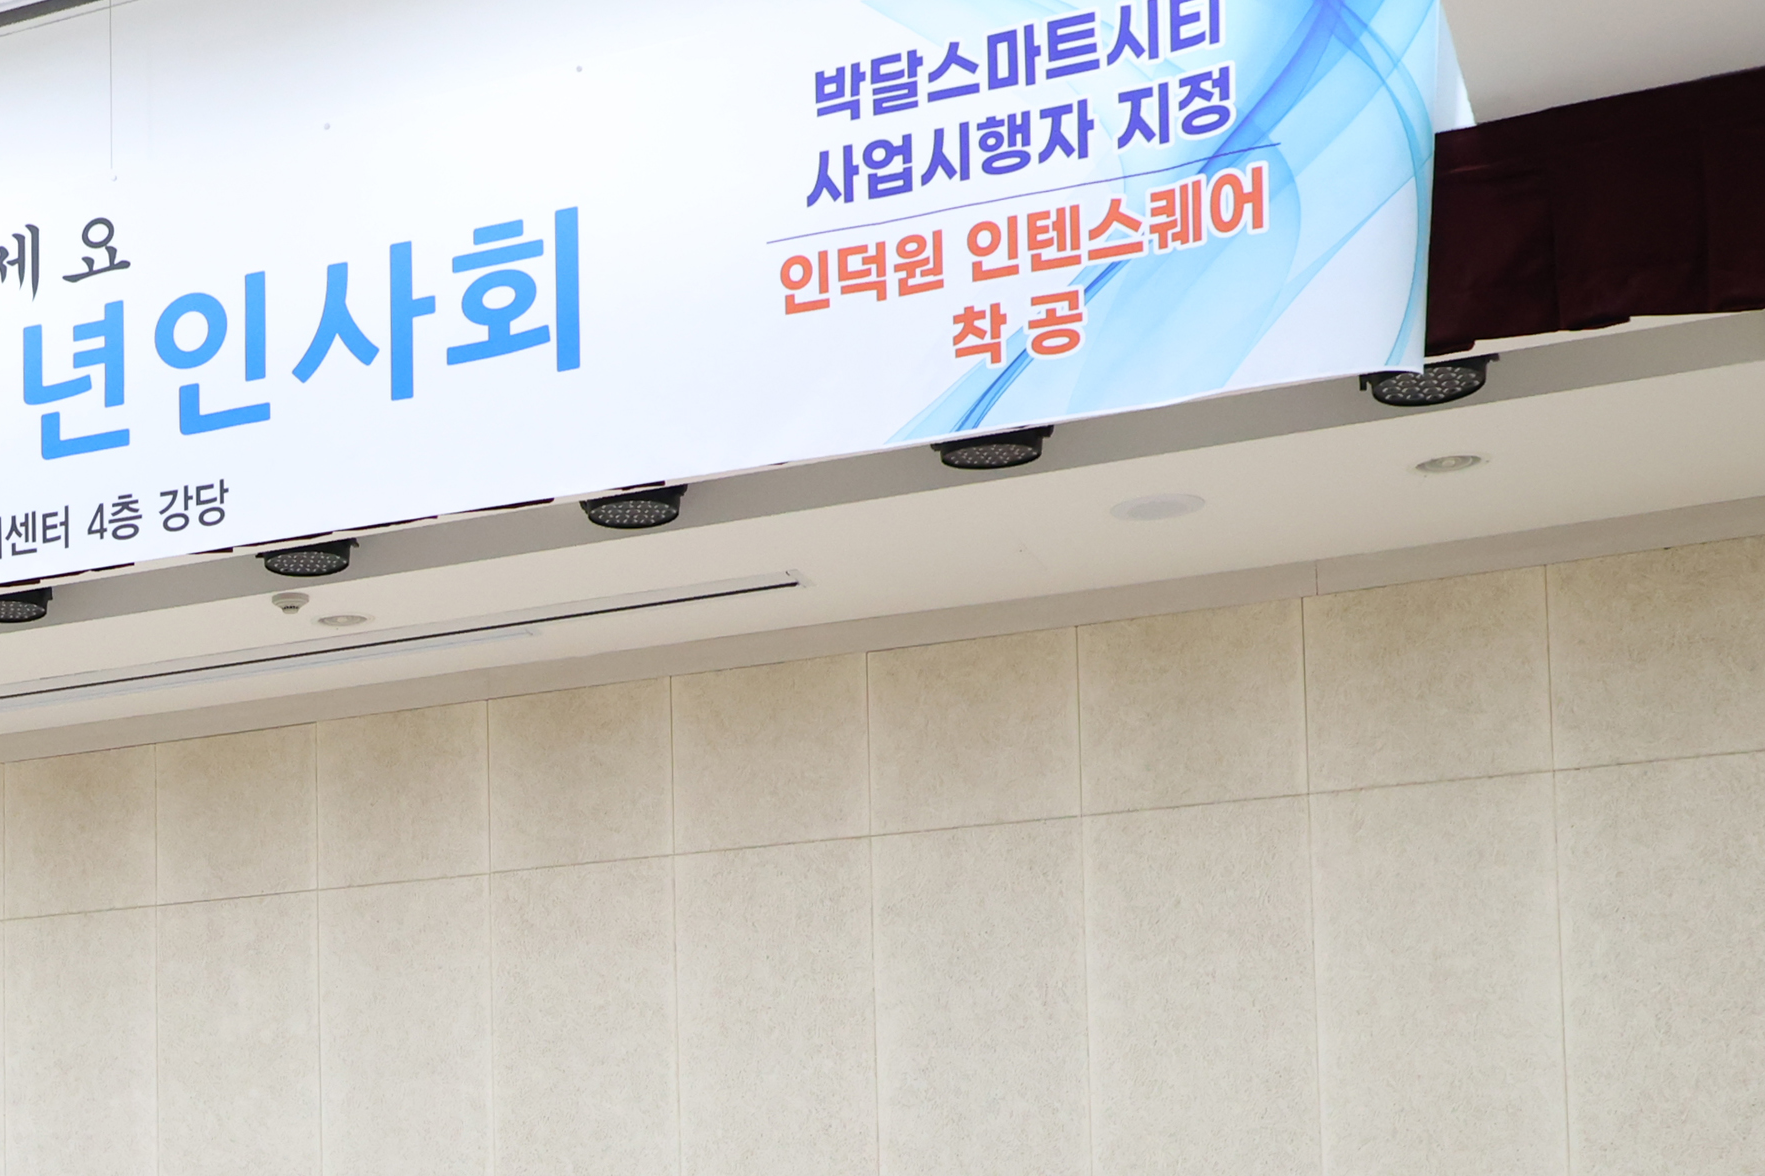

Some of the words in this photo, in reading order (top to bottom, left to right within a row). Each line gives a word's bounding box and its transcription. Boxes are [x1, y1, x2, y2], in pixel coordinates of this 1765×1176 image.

[814, 0, 1222, 120] 박달스마트시티
[806, 97, 1094, 208] 사업시행자
[1117, 66, 1233, 151] 지정
[779, 229, 943, 316] 인덕원
[966, 165, 1266, 283] 인텐스퀘어
[87, 493, 143, 541] 4층
[159, 479, 229, 532] 강당
